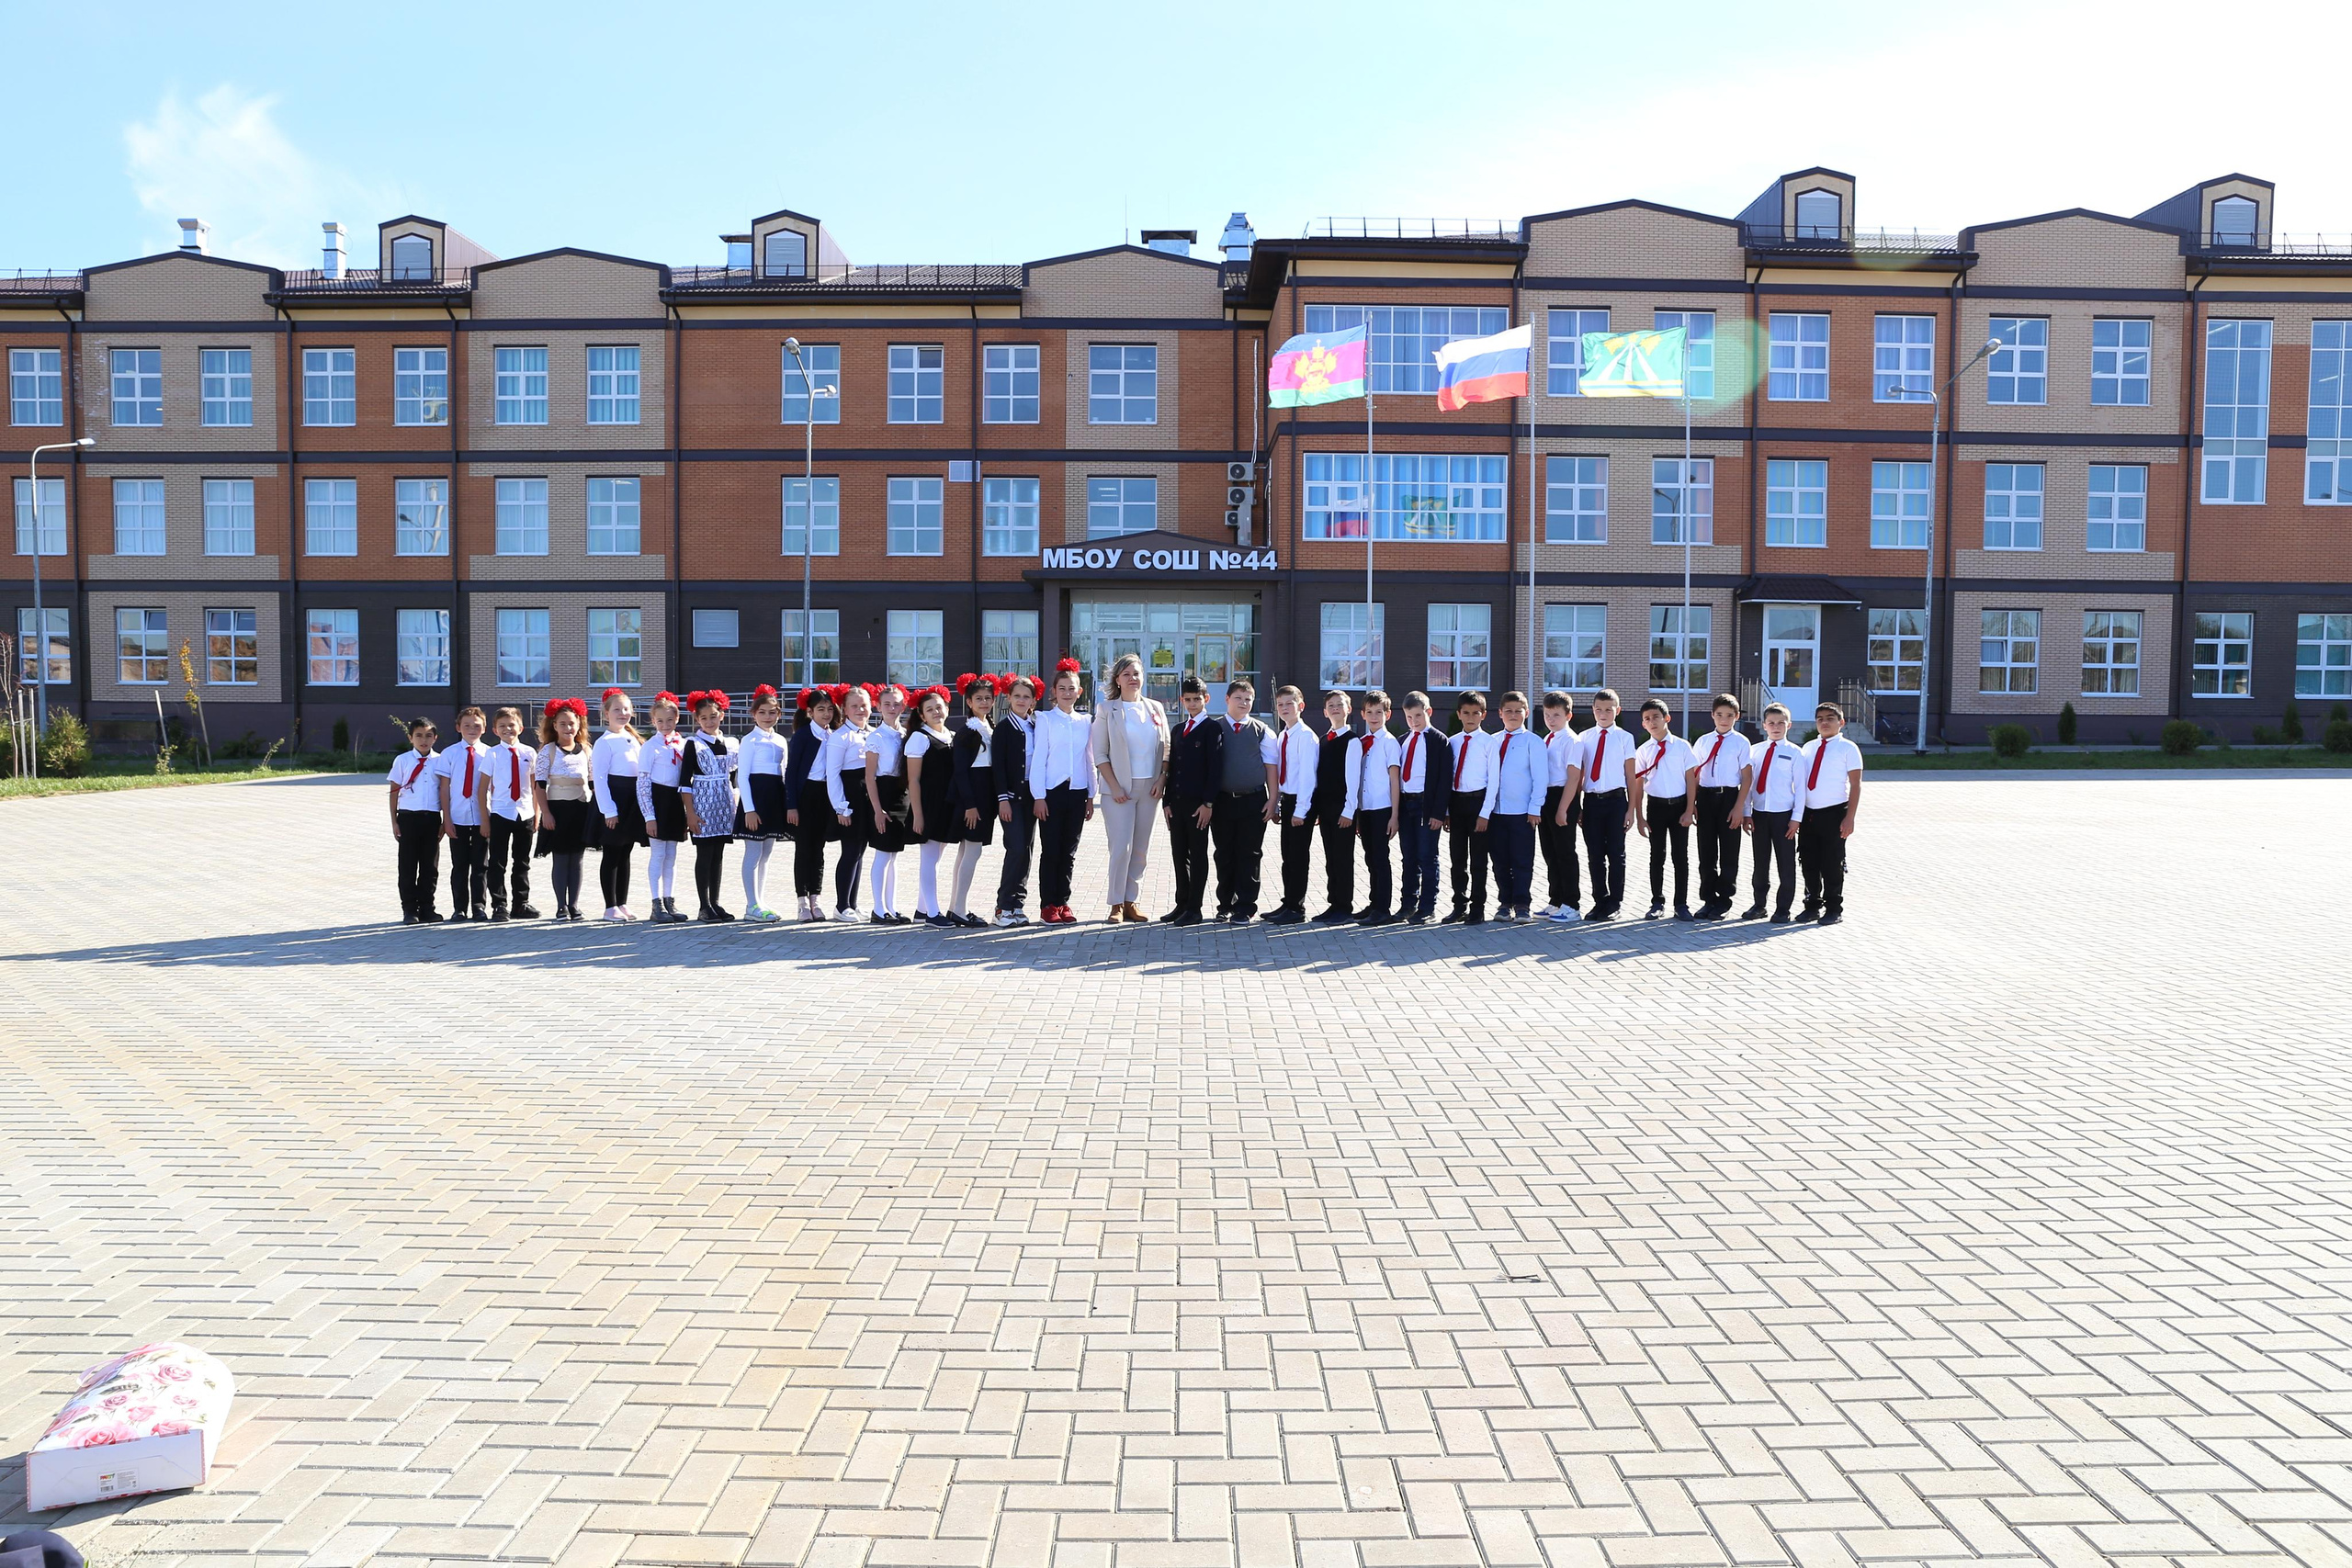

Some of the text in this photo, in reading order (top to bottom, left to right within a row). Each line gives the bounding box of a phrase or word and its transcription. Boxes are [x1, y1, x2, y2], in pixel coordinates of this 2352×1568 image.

[1043, 547, 1277, 570] МБОУ СОШ №44
